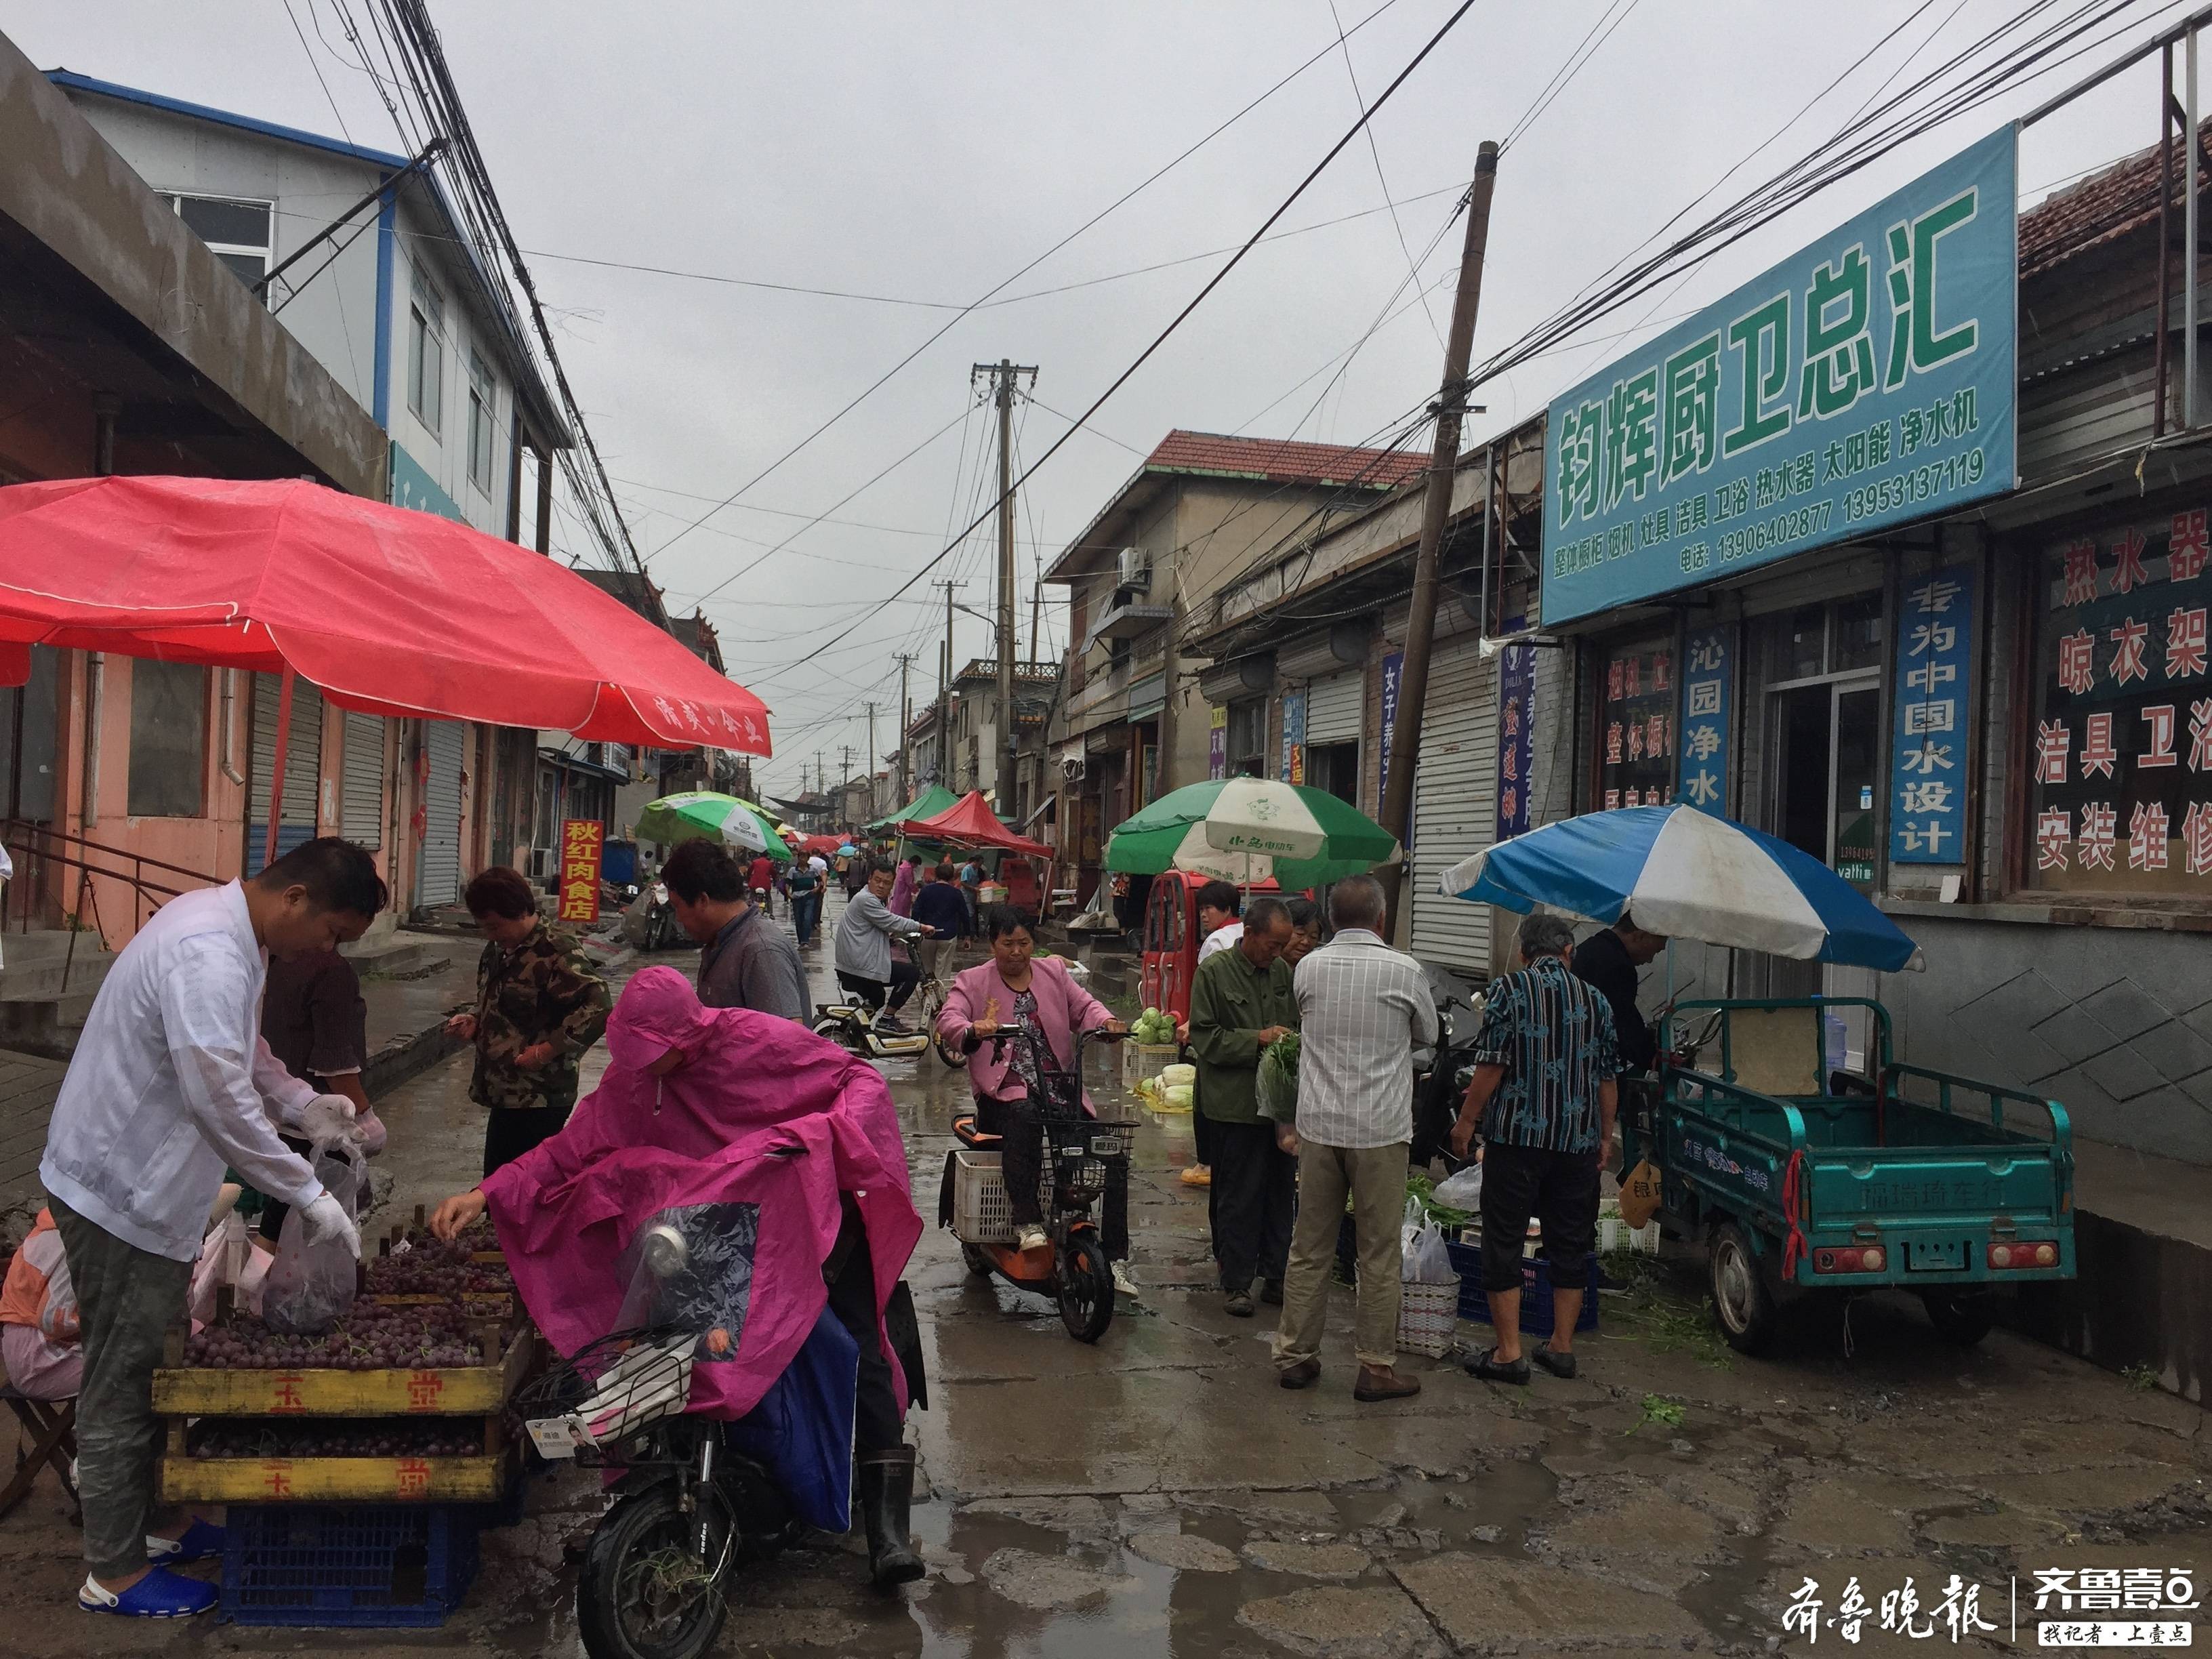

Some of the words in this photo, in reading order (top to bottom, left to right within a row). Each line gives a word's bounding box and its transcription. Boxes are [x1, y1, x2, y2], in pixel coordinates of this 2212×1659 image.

[1559, 184, 1979, 530] 钧辉厨卫总汇
[1553, 535, 1603, 579] 整体橱柜
[1607, 526, 1634, 562] 烟机
[1640, 514, 1670, 550] 灶具
[1676, 498, 1707, 537] 洁具
[1714, 479, 1748, 524] 卫浴
[1756, 453, 1815, 507] 热水器
[1823, 423, 1891, 486] 太阳能
[1900, 387, 1978, 456] 净水机
[1718, 500, 1832, 563] 13906402877
[1844, 449, 1983, 523] 13953137119
[2063, 508, 2211, 607] 热水器
[2060, 607, 2208, 695] 晾衣架
[1685, 636, 1725, 805] 沁园净水
[1899, 580, 1963, 853] 专为中国水设计
[2035, 712, 2116, 784] 洁具
[2138, 697, 2212, 774] 卫浴
[562, 821, 599, 920] 秋红肉食店
[1838, 864, 1862, 880] vatti
[2037, 800, 2212, 876] 安装维修
